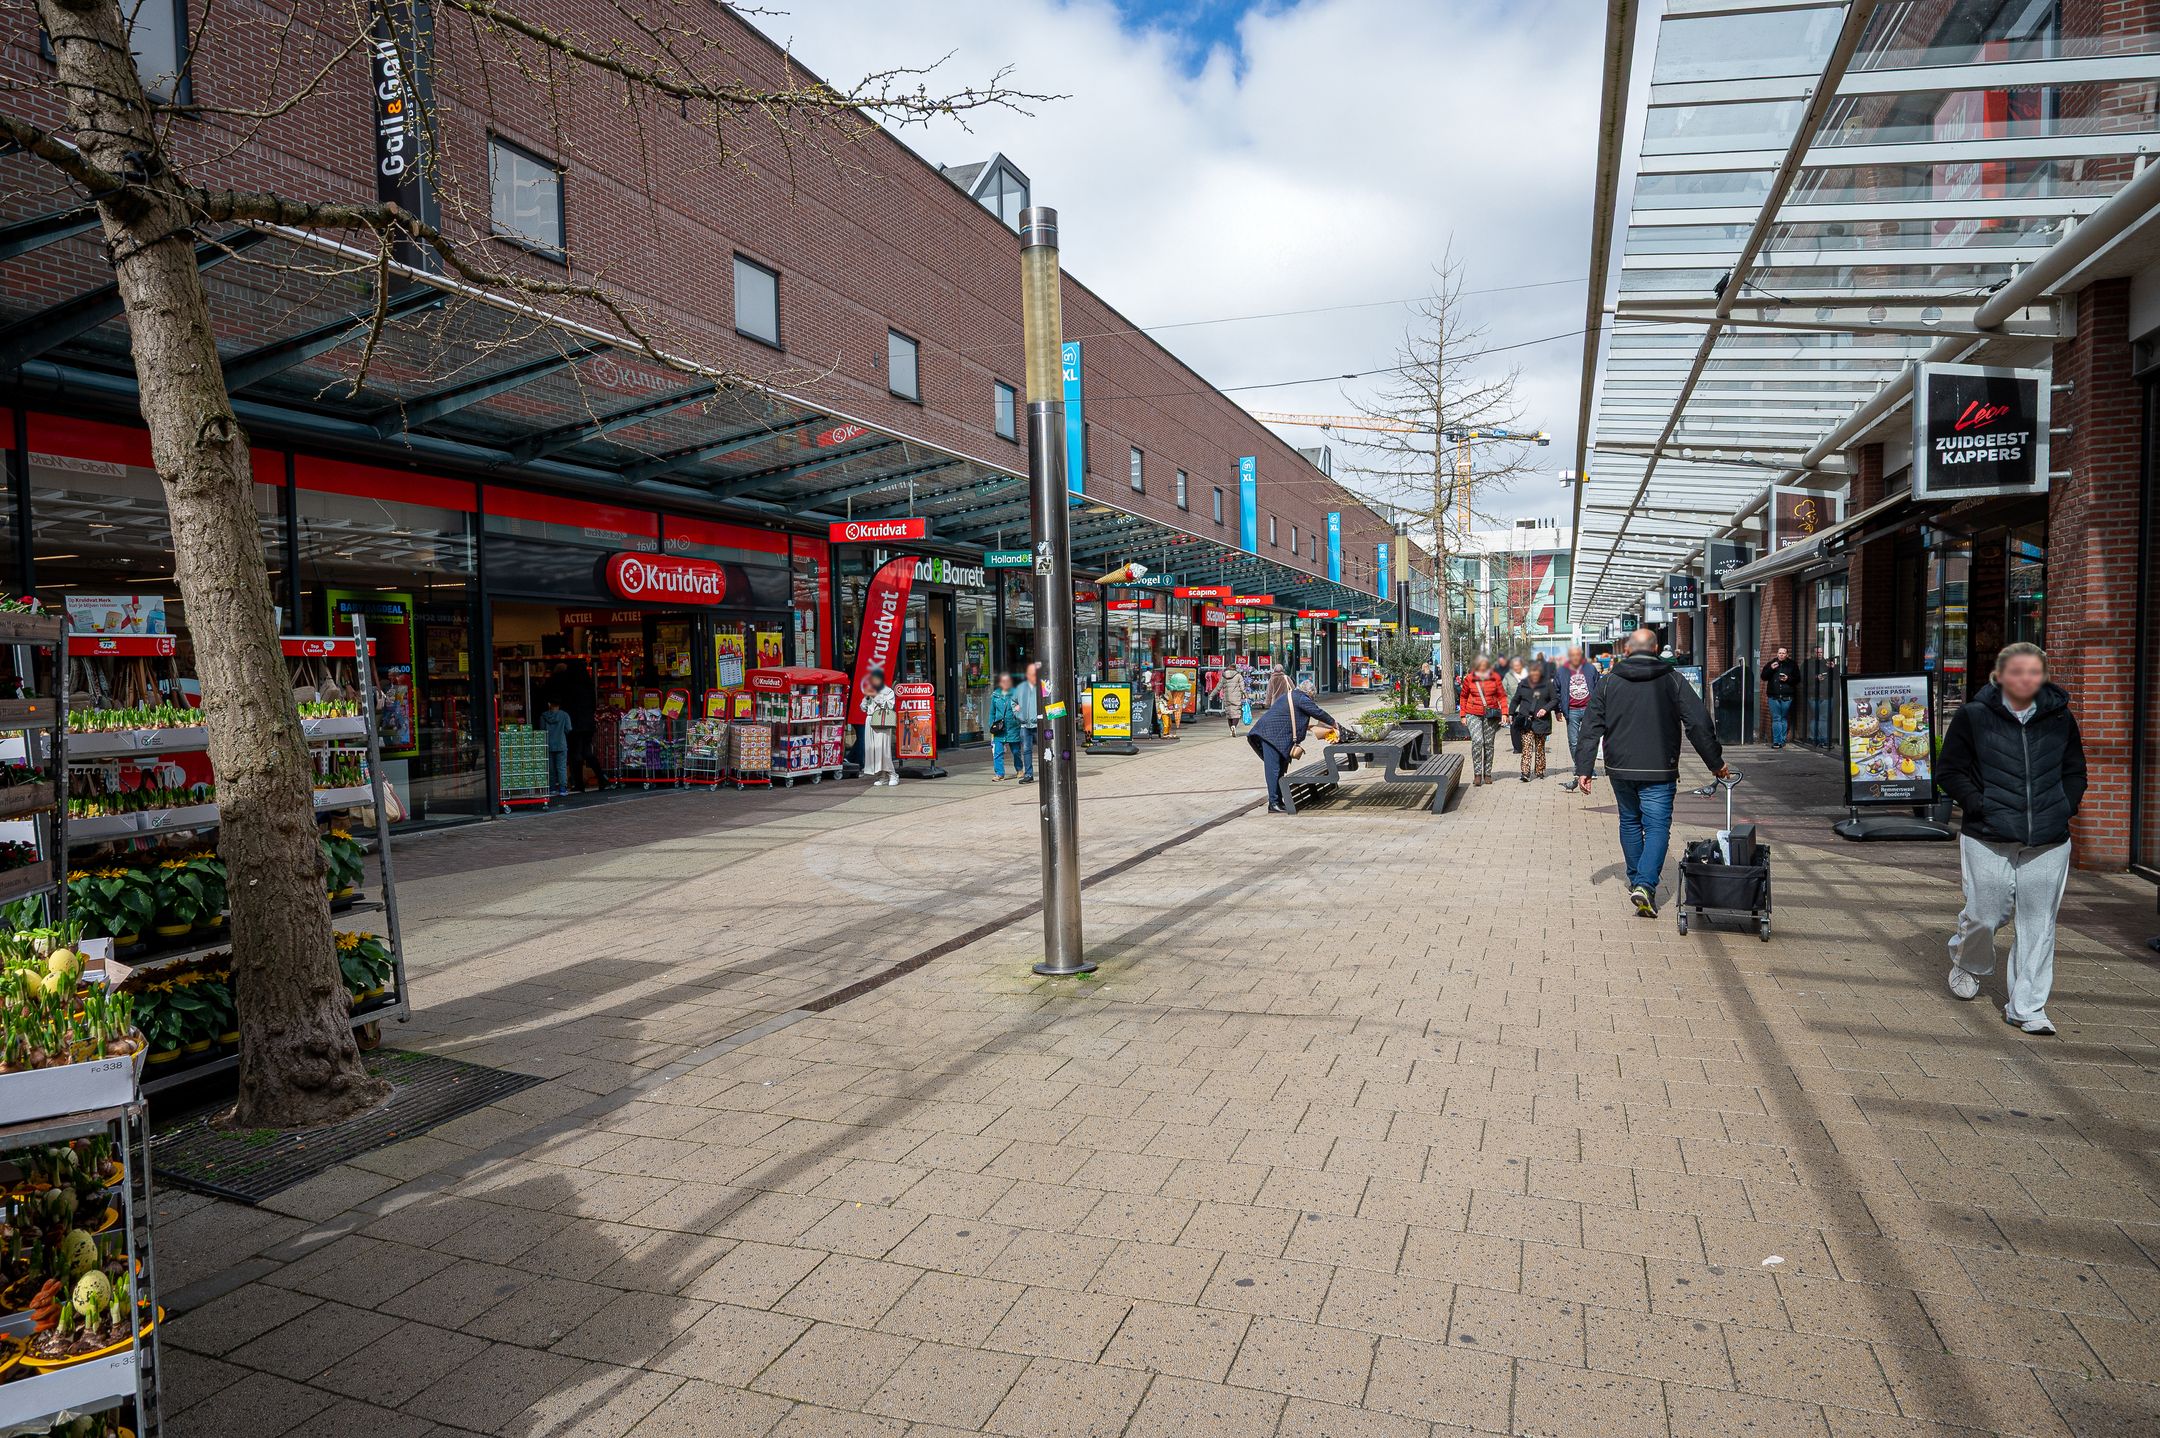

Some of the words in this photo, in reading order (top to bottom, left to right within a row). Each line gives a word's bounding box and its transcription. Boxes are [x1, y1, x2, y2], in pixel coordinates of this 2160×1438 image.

[387, 100, 402, 114] &
[381, 115, 404, 176] Gall
[1063, 368, 1078, 382] XL
[1954, 400, 2010, 431] Léon
[1936, 431, 2029, 450] ZUIDGEEST
[1942, 447, 2021, 465] KAPPERS
[1242, 474, 1254, 482] XL
[860, 523, 907, 537] Kruidvat
[646, 564, 720, 595] Kruidvat
[1188, 588, 1217, 598] scapino
[1235, 597, 1261, 605] scapino
[564, 612, 592, 624] ACTIE!
[611, 611, 641, 622] ACTIE!
[1207, 610, 1225, 626] scapino
[867, 590, 899, 671] Kruidvat
[1167, 659, 1196, 667] scapino
[759, 677, 780, 686] Kruidvat
[904, 686, 930, 694] Kruidvat
[901, 700, 930, 709] ACTIE!
[103, 1061, 123, 1071] 338
[123, 1355, 136, 1366] 33
